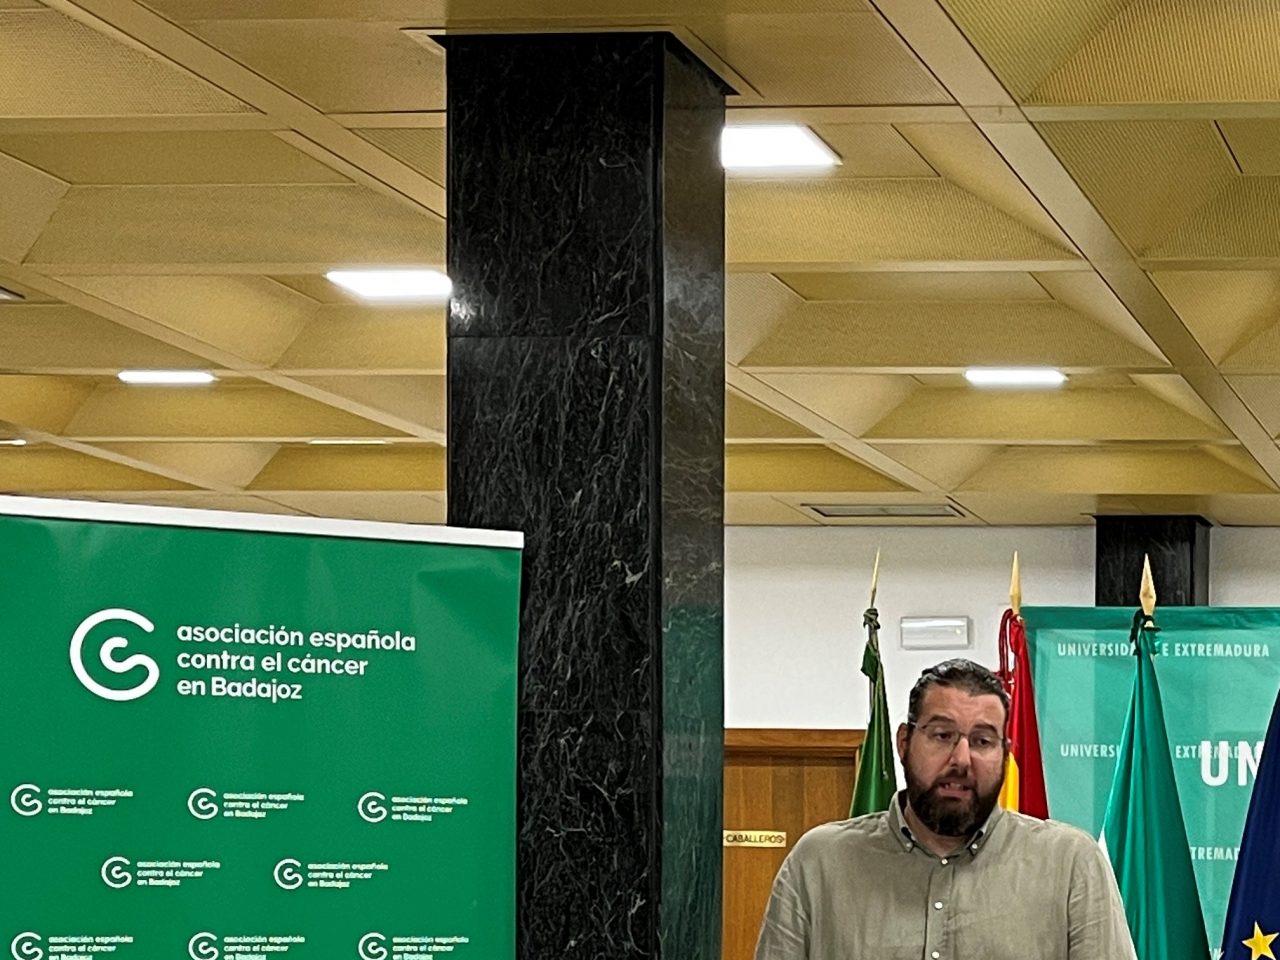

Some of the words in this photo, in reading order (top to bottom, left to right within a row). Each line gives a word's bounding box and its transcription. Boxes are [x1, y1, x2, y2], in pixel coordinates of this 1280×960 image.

[177, 623, 303, 646] asociación
[309, 630, 416, 652] española
[1175, 643, 1269, 657] EXTREMADURA
[177, 650, 255, 670] contra
[261, 652, 281, 671] el
[287, 653, 368, 675] cáncer
[177, 679, 206, 695] en
[211, 677, 303, 703] Badajoz
[726, 834, 784, 843] CABALLEROS
